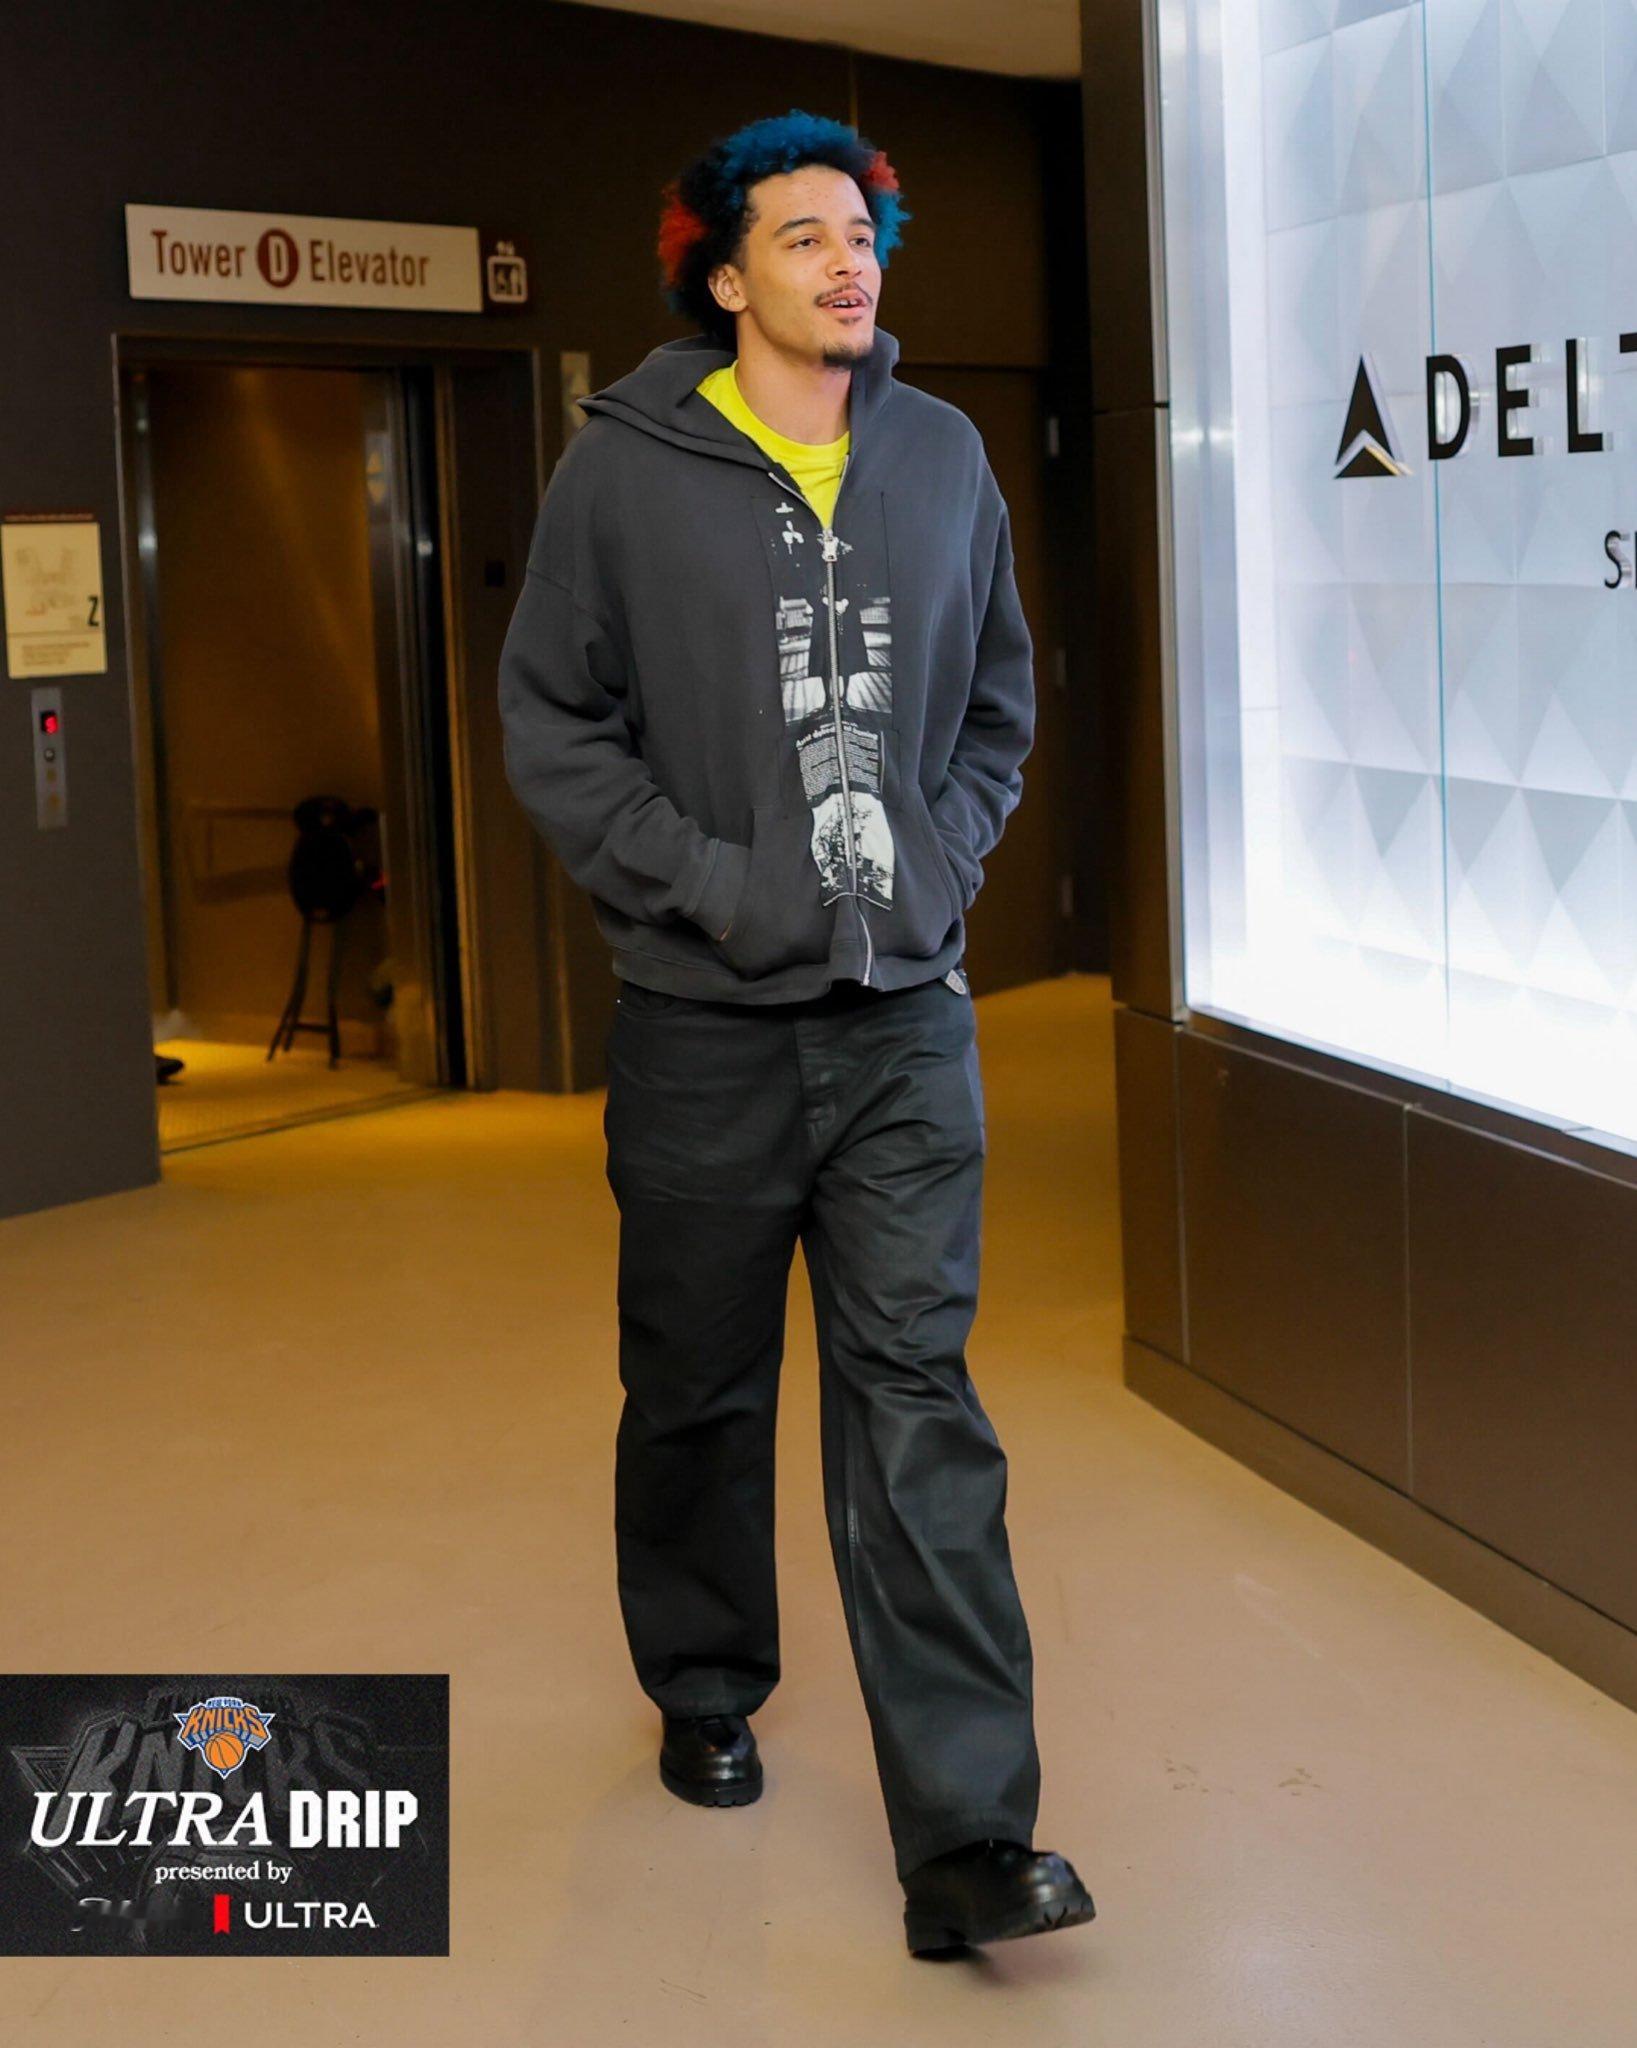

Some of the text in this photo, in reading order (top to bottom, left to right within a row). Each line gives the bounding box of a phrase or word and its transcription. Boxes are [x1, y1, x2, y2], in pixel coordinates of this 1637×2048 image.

[152, 230, 429, 286] Tower D Elevator
[1605, 531, 1637, 588] S
